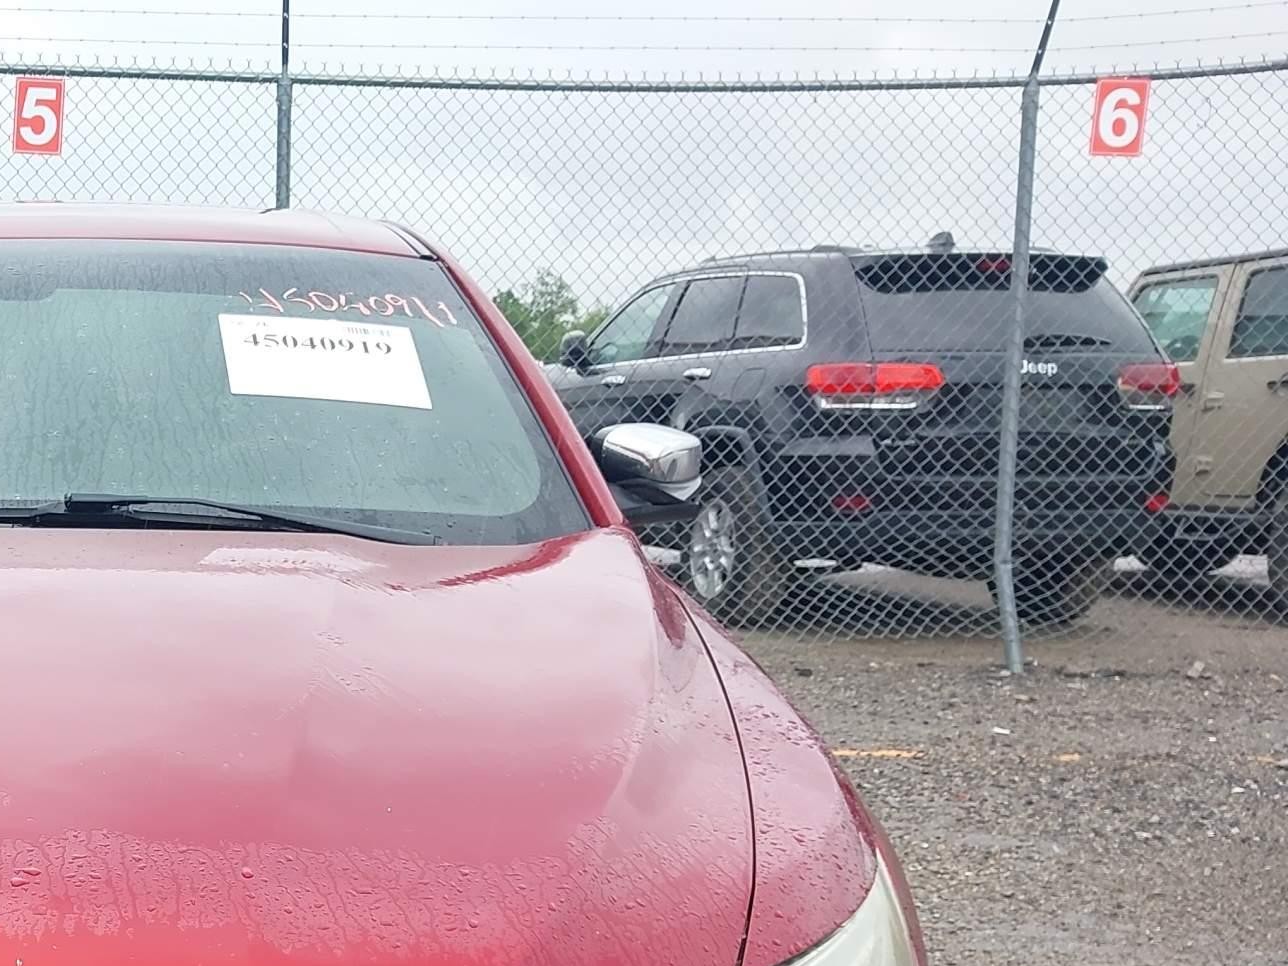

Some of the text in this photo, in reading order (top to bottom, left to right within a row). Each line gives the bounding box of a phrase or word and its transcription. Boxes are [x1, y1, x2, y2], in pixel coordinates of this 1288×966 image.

[19, 86, 58, 146] 5
[1098, 86, 1141, 148] 6
[243, 333, 392, 354] 45040919
[1020, 359, 1058, 377] Jeep
